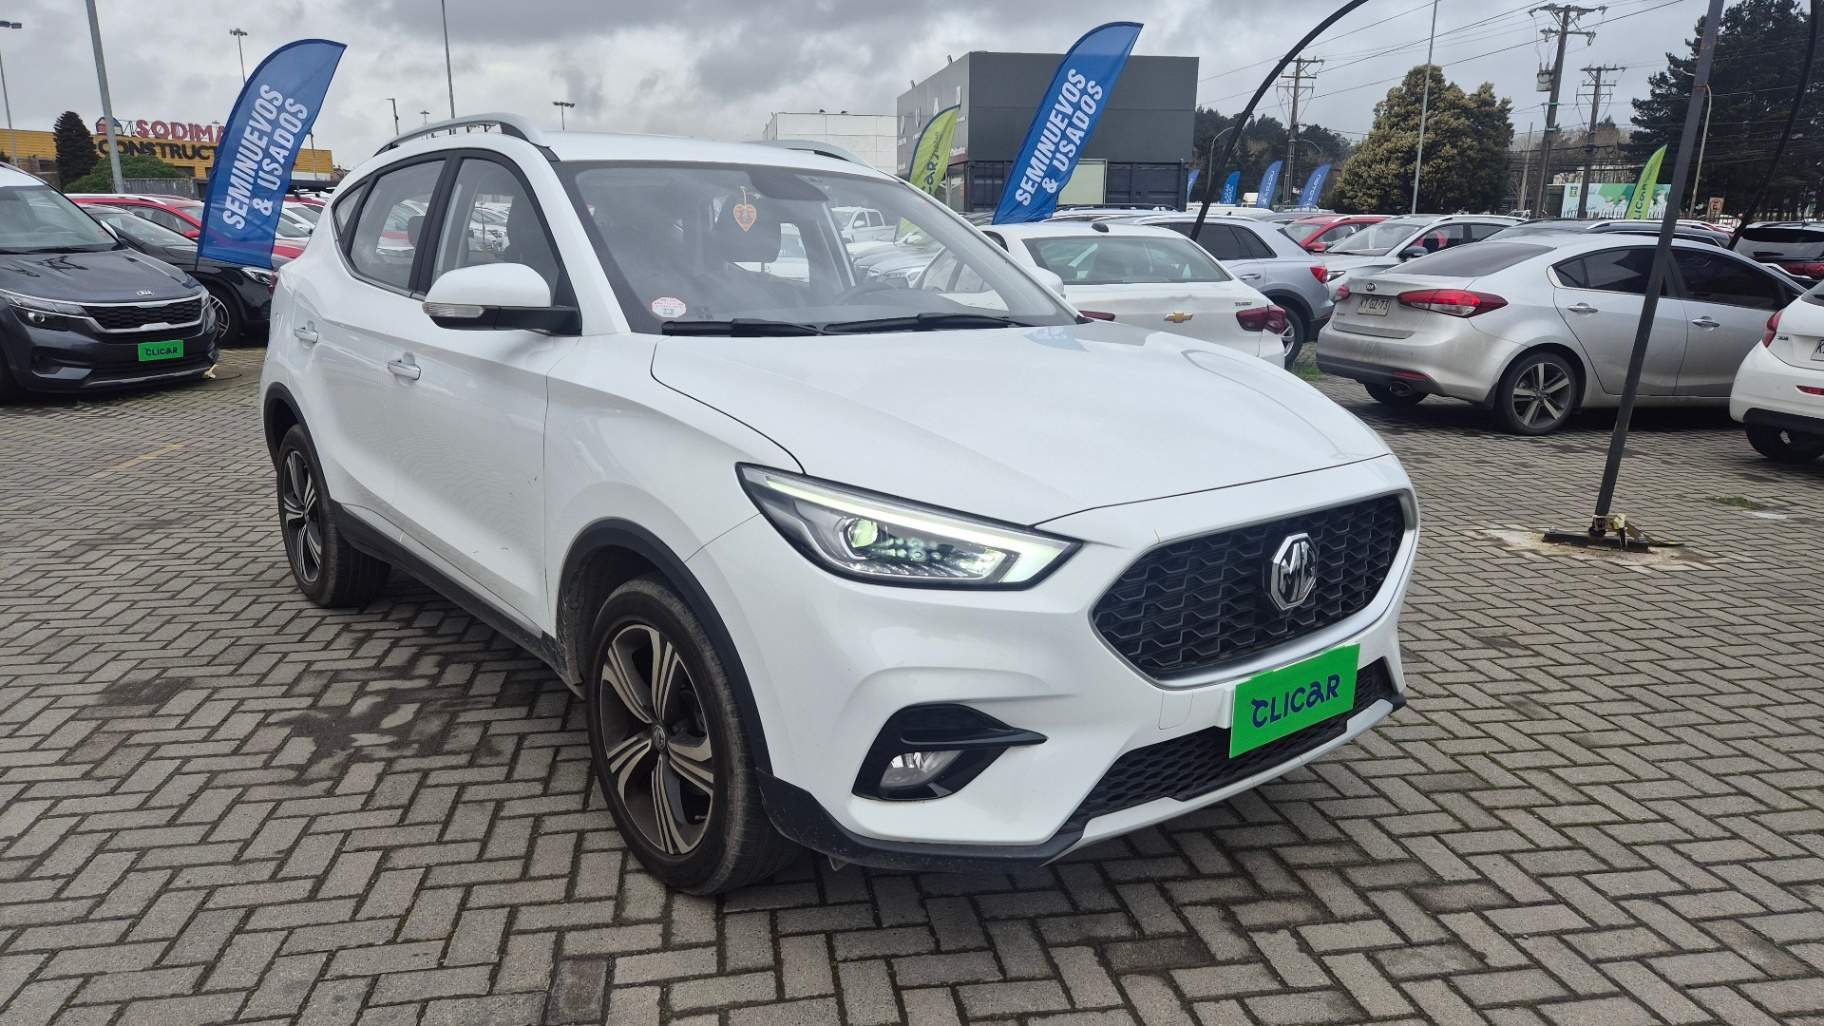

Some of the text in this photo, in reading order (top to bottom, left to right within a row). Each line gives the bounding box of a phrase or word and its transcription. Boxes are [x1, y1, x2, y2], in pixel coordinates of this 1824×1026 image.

[222, 84, 283, 230] SEMINUEVOS
[252, 98, 308, 217] & USADOS
[1015, 68, 1086, 206] SEMINUEVOS
[1041, 80, 1103, 194] & USADOS
